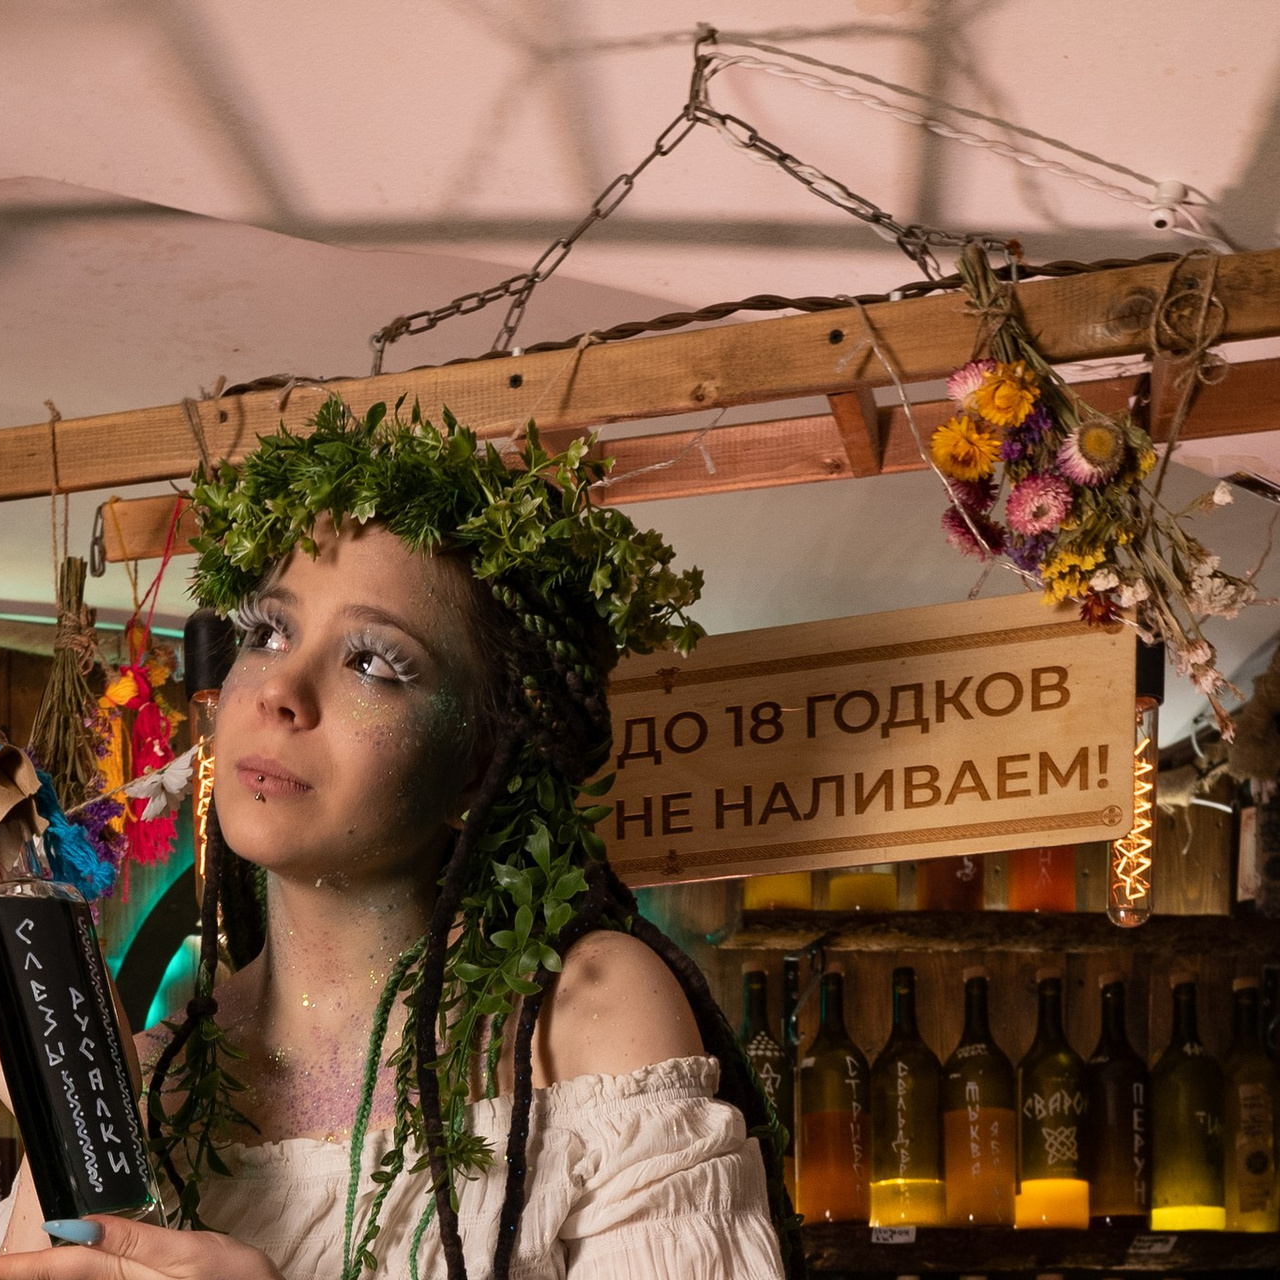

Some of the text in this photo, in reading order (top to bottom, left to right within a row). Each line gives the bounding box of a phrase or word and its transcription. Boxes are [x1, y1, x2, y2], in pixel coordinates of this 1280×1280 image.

[618, 665, 1072, 769] ДО 18 ГОДКОВ
[616, 744, 1110, 840] НЕ НАЛИВАЕМ!
[1132, 1082, 1146, 1206] ПЕРУН
